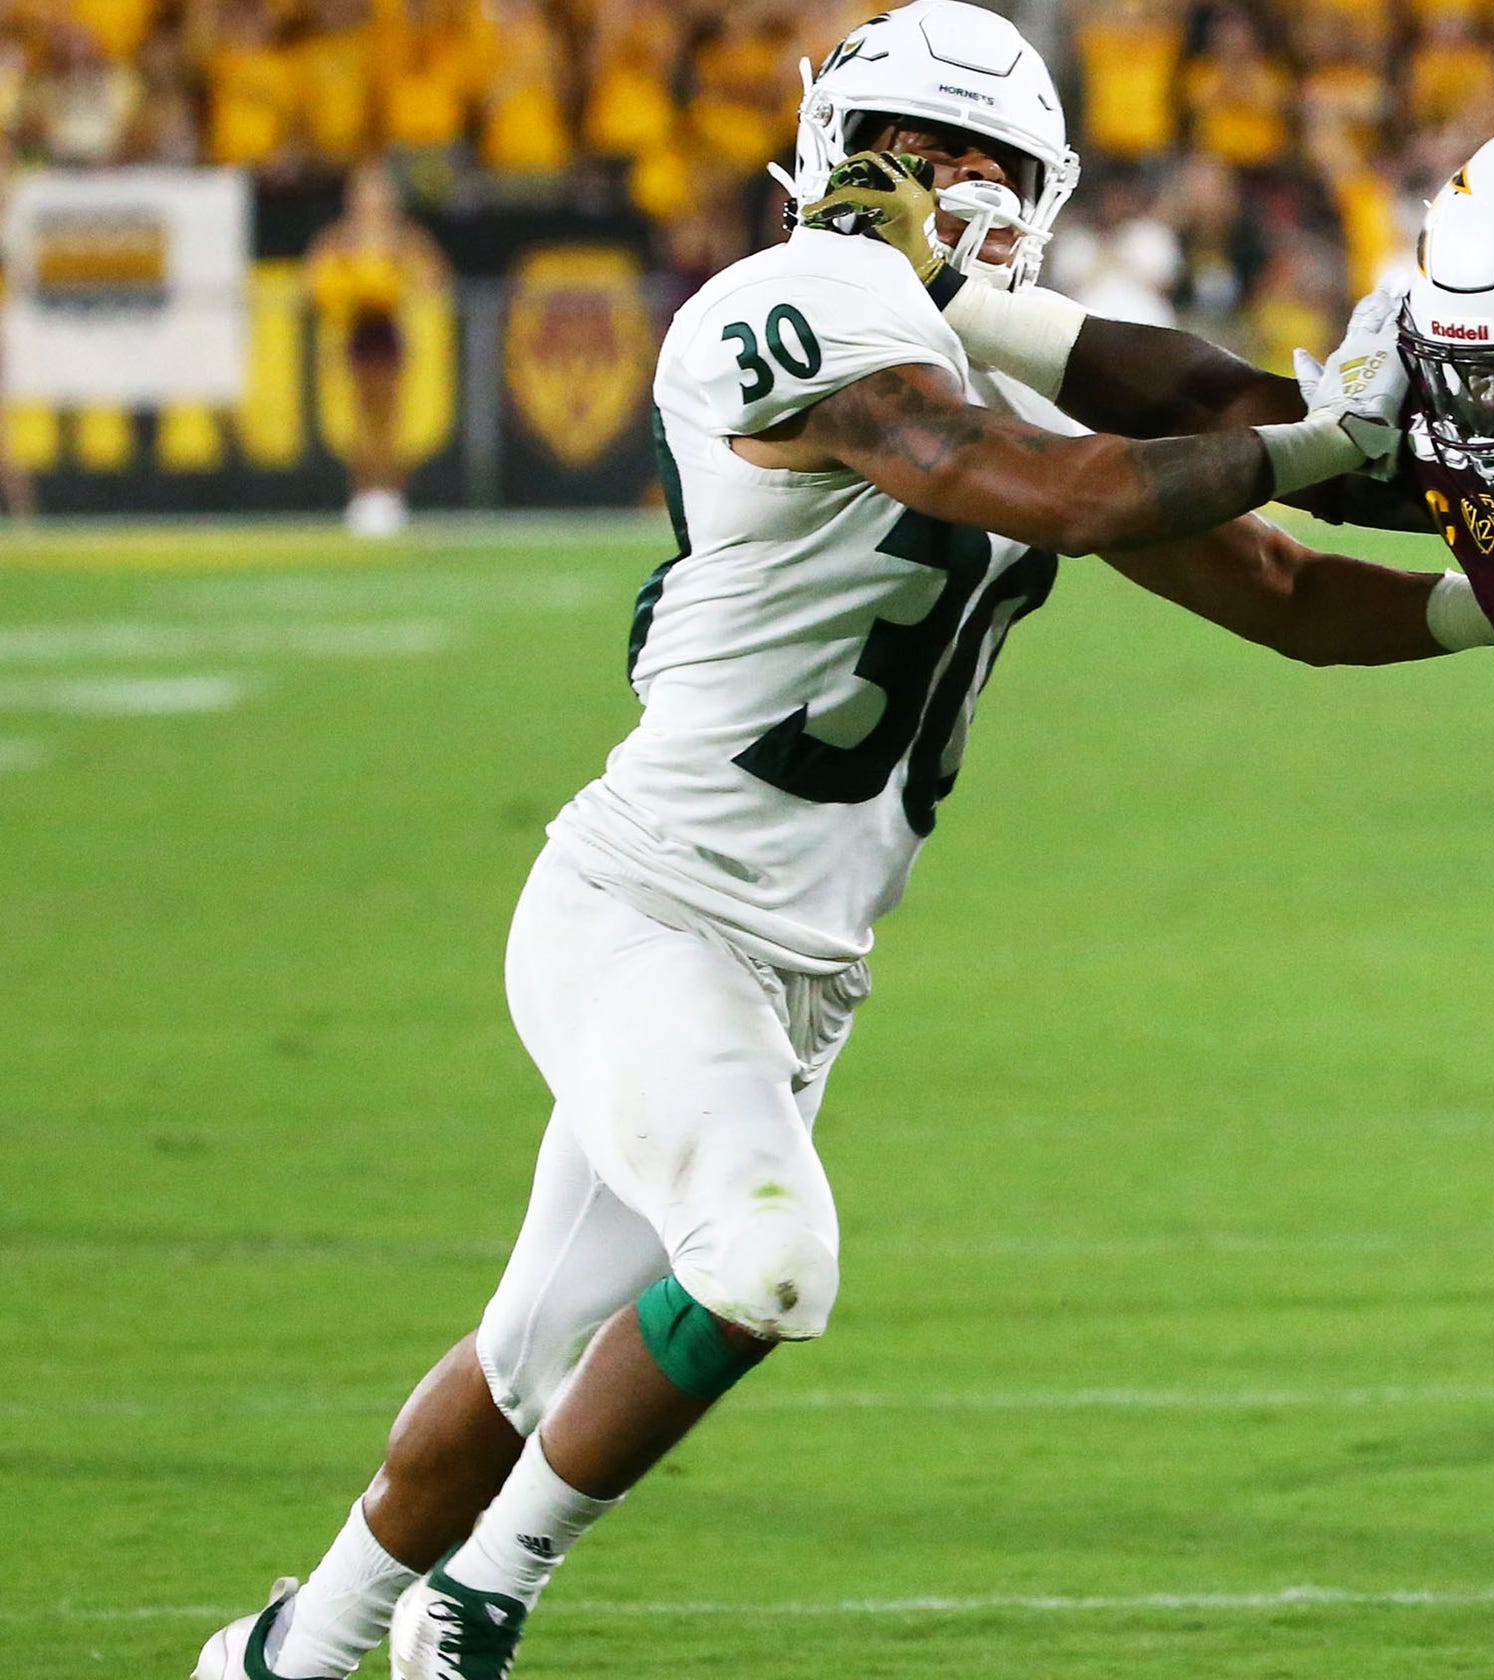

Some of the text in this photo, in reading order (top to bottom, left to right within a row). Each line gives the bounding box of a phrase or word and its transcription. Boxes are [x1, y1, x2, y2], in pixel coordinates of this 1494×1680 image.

[938, 83, 995, 106] HORNETS
[721, 303, 822, 405] 30
[1431, 320, 1489, 341] Riddell
[730, 505, 1059, 838] 30
